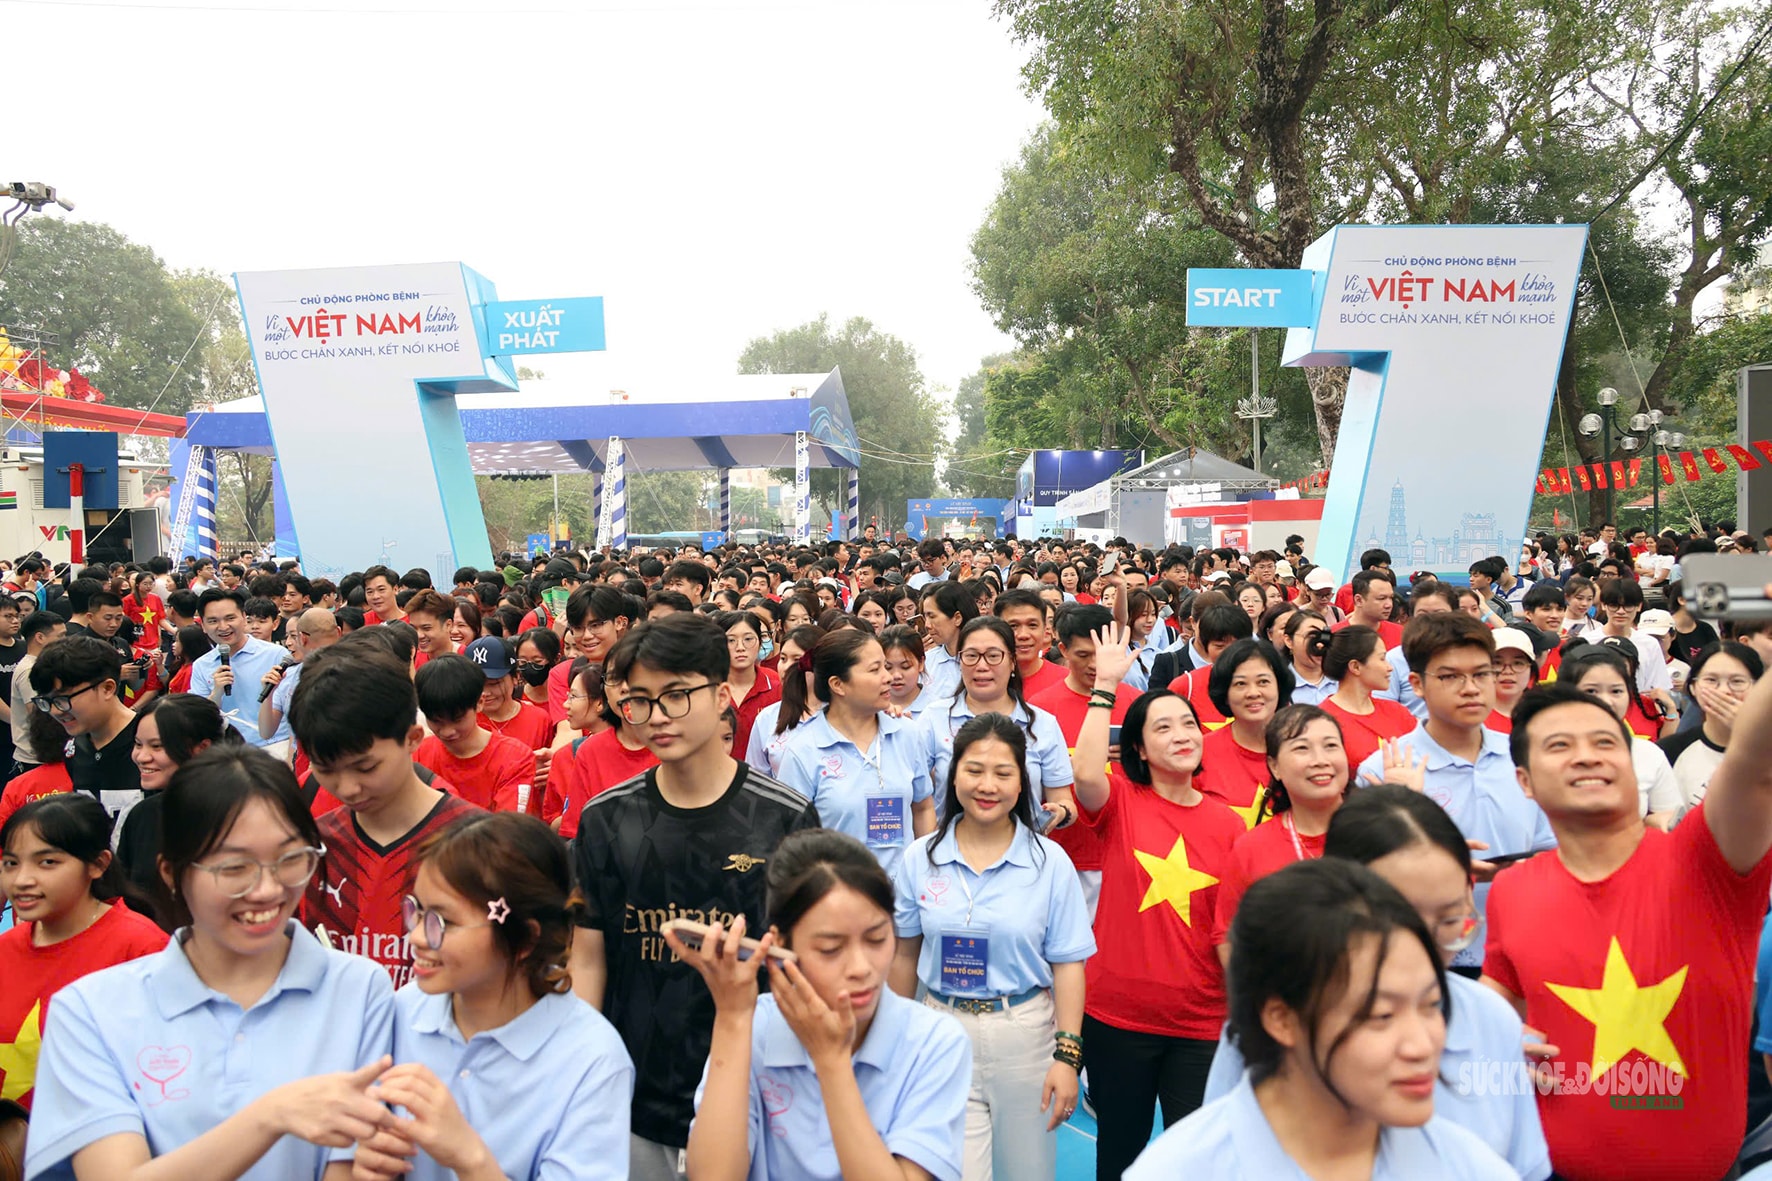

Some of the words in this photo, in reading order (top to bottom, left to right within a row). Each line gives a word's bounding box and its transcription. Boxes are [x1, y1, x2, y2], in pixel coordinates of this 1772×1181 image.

[1384, 255, 1408, 266] CHỦ
[1410, 255, 1442, 268] ĐỘNG
[1445, 255, 1484, 266] PHÒNG
[1487, 255, 1517, 268] BỆNH
[1344, 274, 1360, 291] Vì
[1367, 269, 1434, 310] VIỆT
[1444, 278, 1516, 303] NAM
[300, 295, 321, 305] CHỦ
[323, 294, 353, 305] ĐỘNG
[355, 292, 390, 303] PHÒNG
[392, 291, 420, 302] BỆNH
[1194, 287, 1281, 307] START
[1341, 288, 1371, 307] một
[1518, 285, 1557, 306] mạnh
[286, 307, 347, 345] VIỆT
[356, 311, 421, 336] NAM
[504, 303, 565, 329] XUẤT
[1420, 312, 1462, 325] XANH,
[1465, 310, 1488, 324] KẾT
[1492, 310, 1516, 324] NỐI
[264, 326, 291, 346] một
[424, 317, 460, 337] mạnh
[499, 326, 560, 349] PHÁT
[338, 346, 376, 358] XANH,
[378, 342, 400, 355] KẾT
[402, 341, 425, 354] NỐI
[641, 937, 665, 962] FLY
[943, 966, 957, 974] BAN
